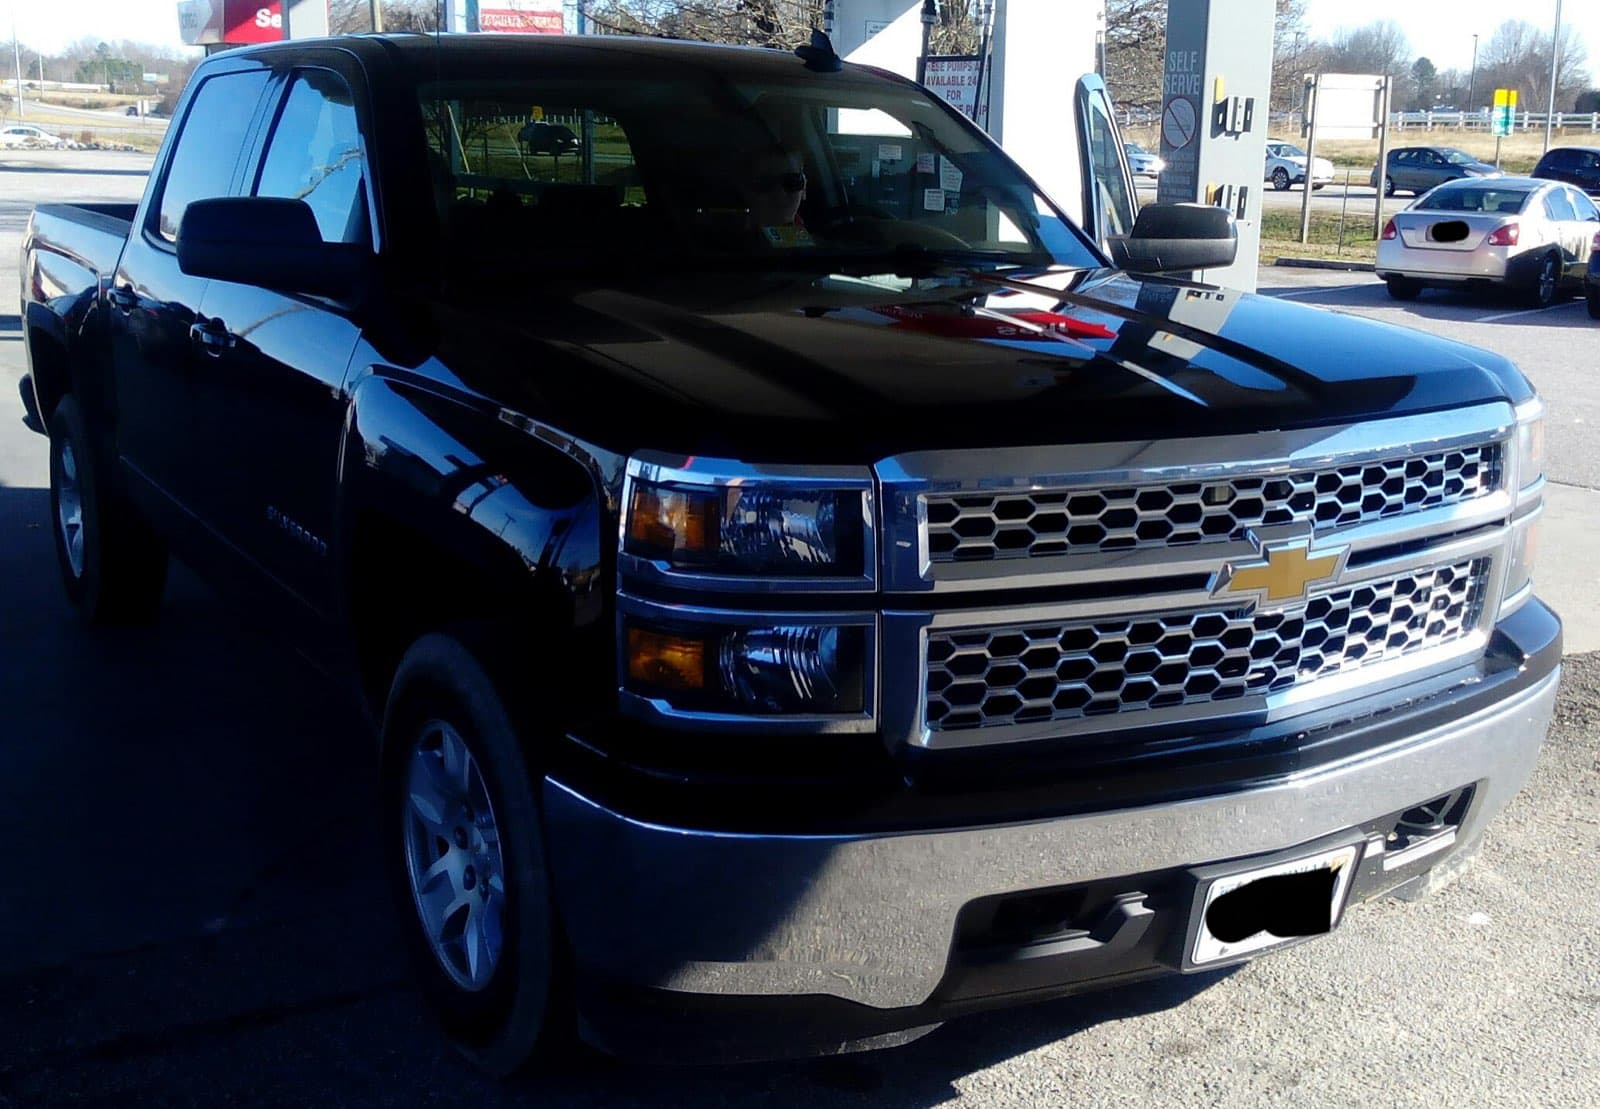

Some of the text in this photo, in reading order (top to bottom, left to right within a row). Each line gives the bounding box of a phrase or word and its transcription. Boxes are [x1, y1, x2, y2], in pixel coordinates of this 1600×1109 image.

[946, 61, 974, 73] PUMPS
[1169, 51, 1198, 72] SELF
[926, 75, 966, 87] AVAILABLE
[1164, 74, 1200, 95] SERVE
[946, 89, 962, 101] FOR
[965, 103, 988, 115] PUP
